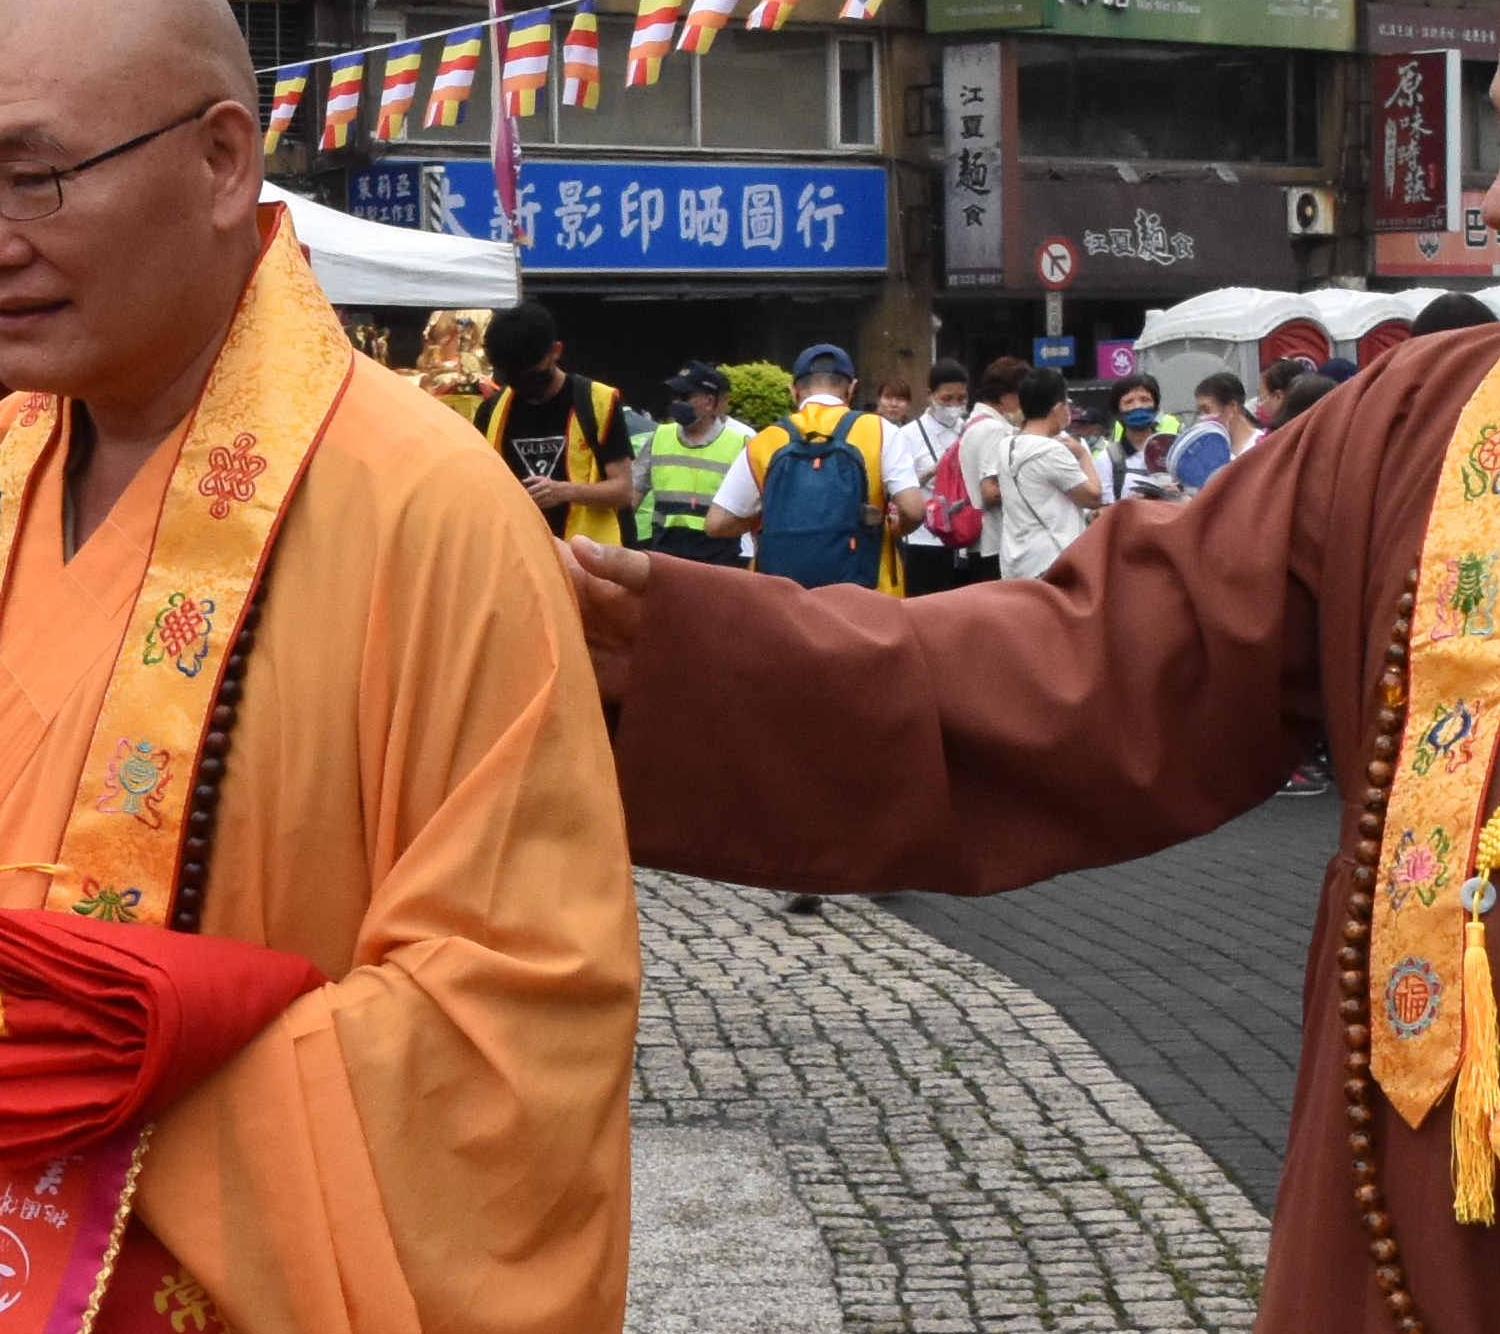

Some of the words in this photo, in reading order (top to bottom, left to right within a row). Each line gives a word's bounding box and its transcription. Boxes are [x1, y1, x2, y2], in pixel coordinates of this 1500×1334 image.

[1384, 61, 1433, 204] 原味時蔬
[521, 443, 559, 456] GUESS
